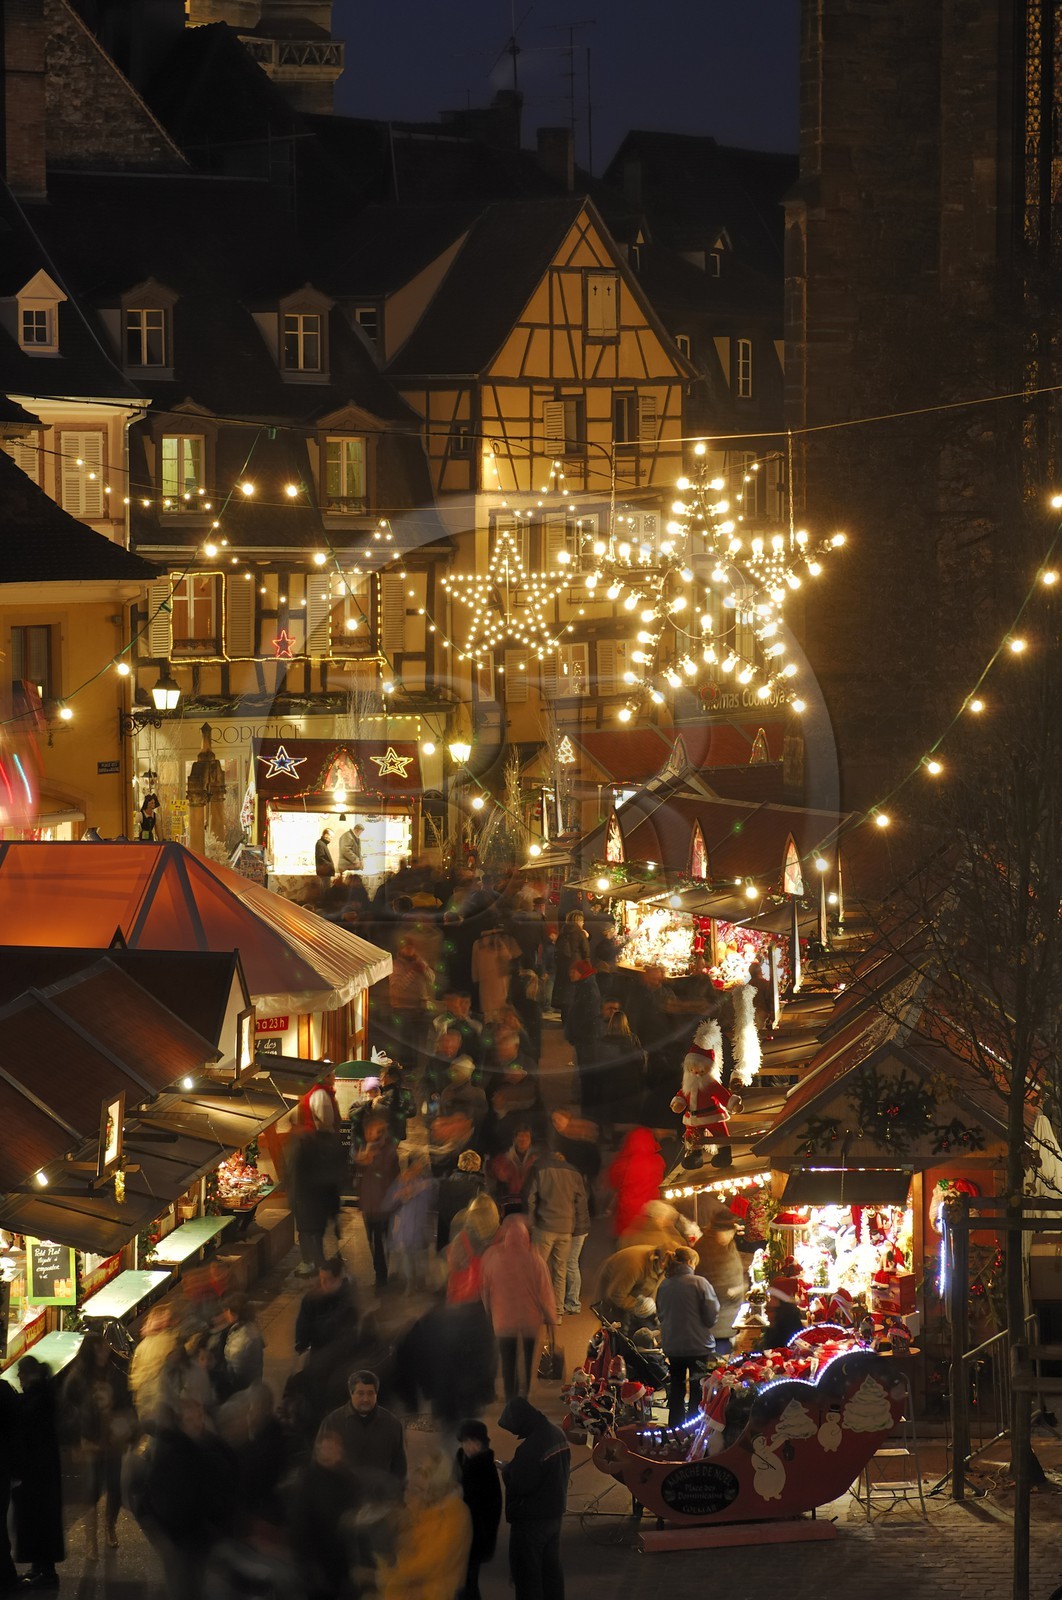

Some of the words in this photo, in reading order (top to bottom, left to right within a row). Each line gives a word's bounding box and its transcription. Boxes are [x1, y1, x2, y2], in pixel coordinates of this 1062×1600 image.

[702, 693, 740, 711] mas
[199, 724, 302, 744] ROPIC'ICE
[269, 1018, 279, 1029] 23
[280, 1017, 286, 1028] h
[702, 1466, 713, 1477] DE
